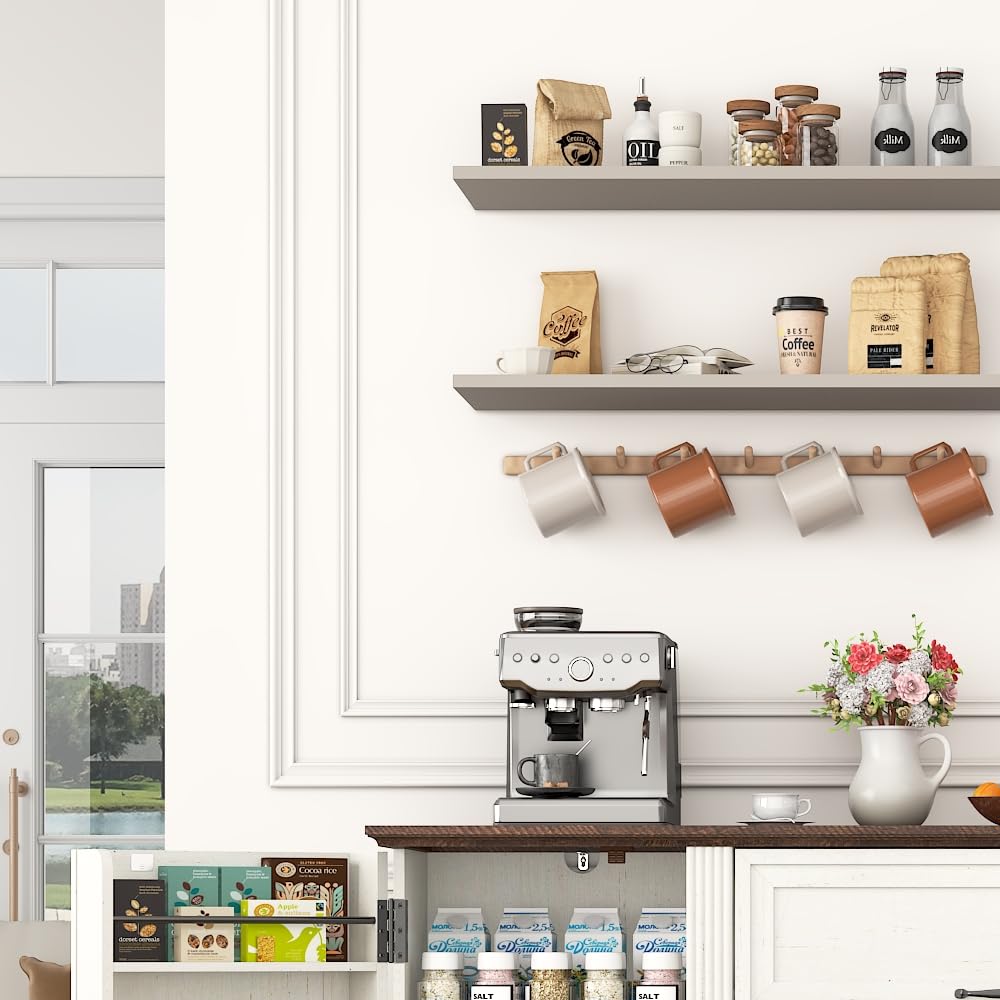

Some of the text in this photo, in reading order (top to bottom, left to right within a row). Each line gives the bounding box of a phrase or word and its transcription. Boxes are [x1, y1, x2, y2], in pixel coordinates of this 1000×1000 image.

[627, 142, 659, 159] OIL
[782, 338, 815, 350] Coffee
[298, 866, 338, 875] Cocoa rice
